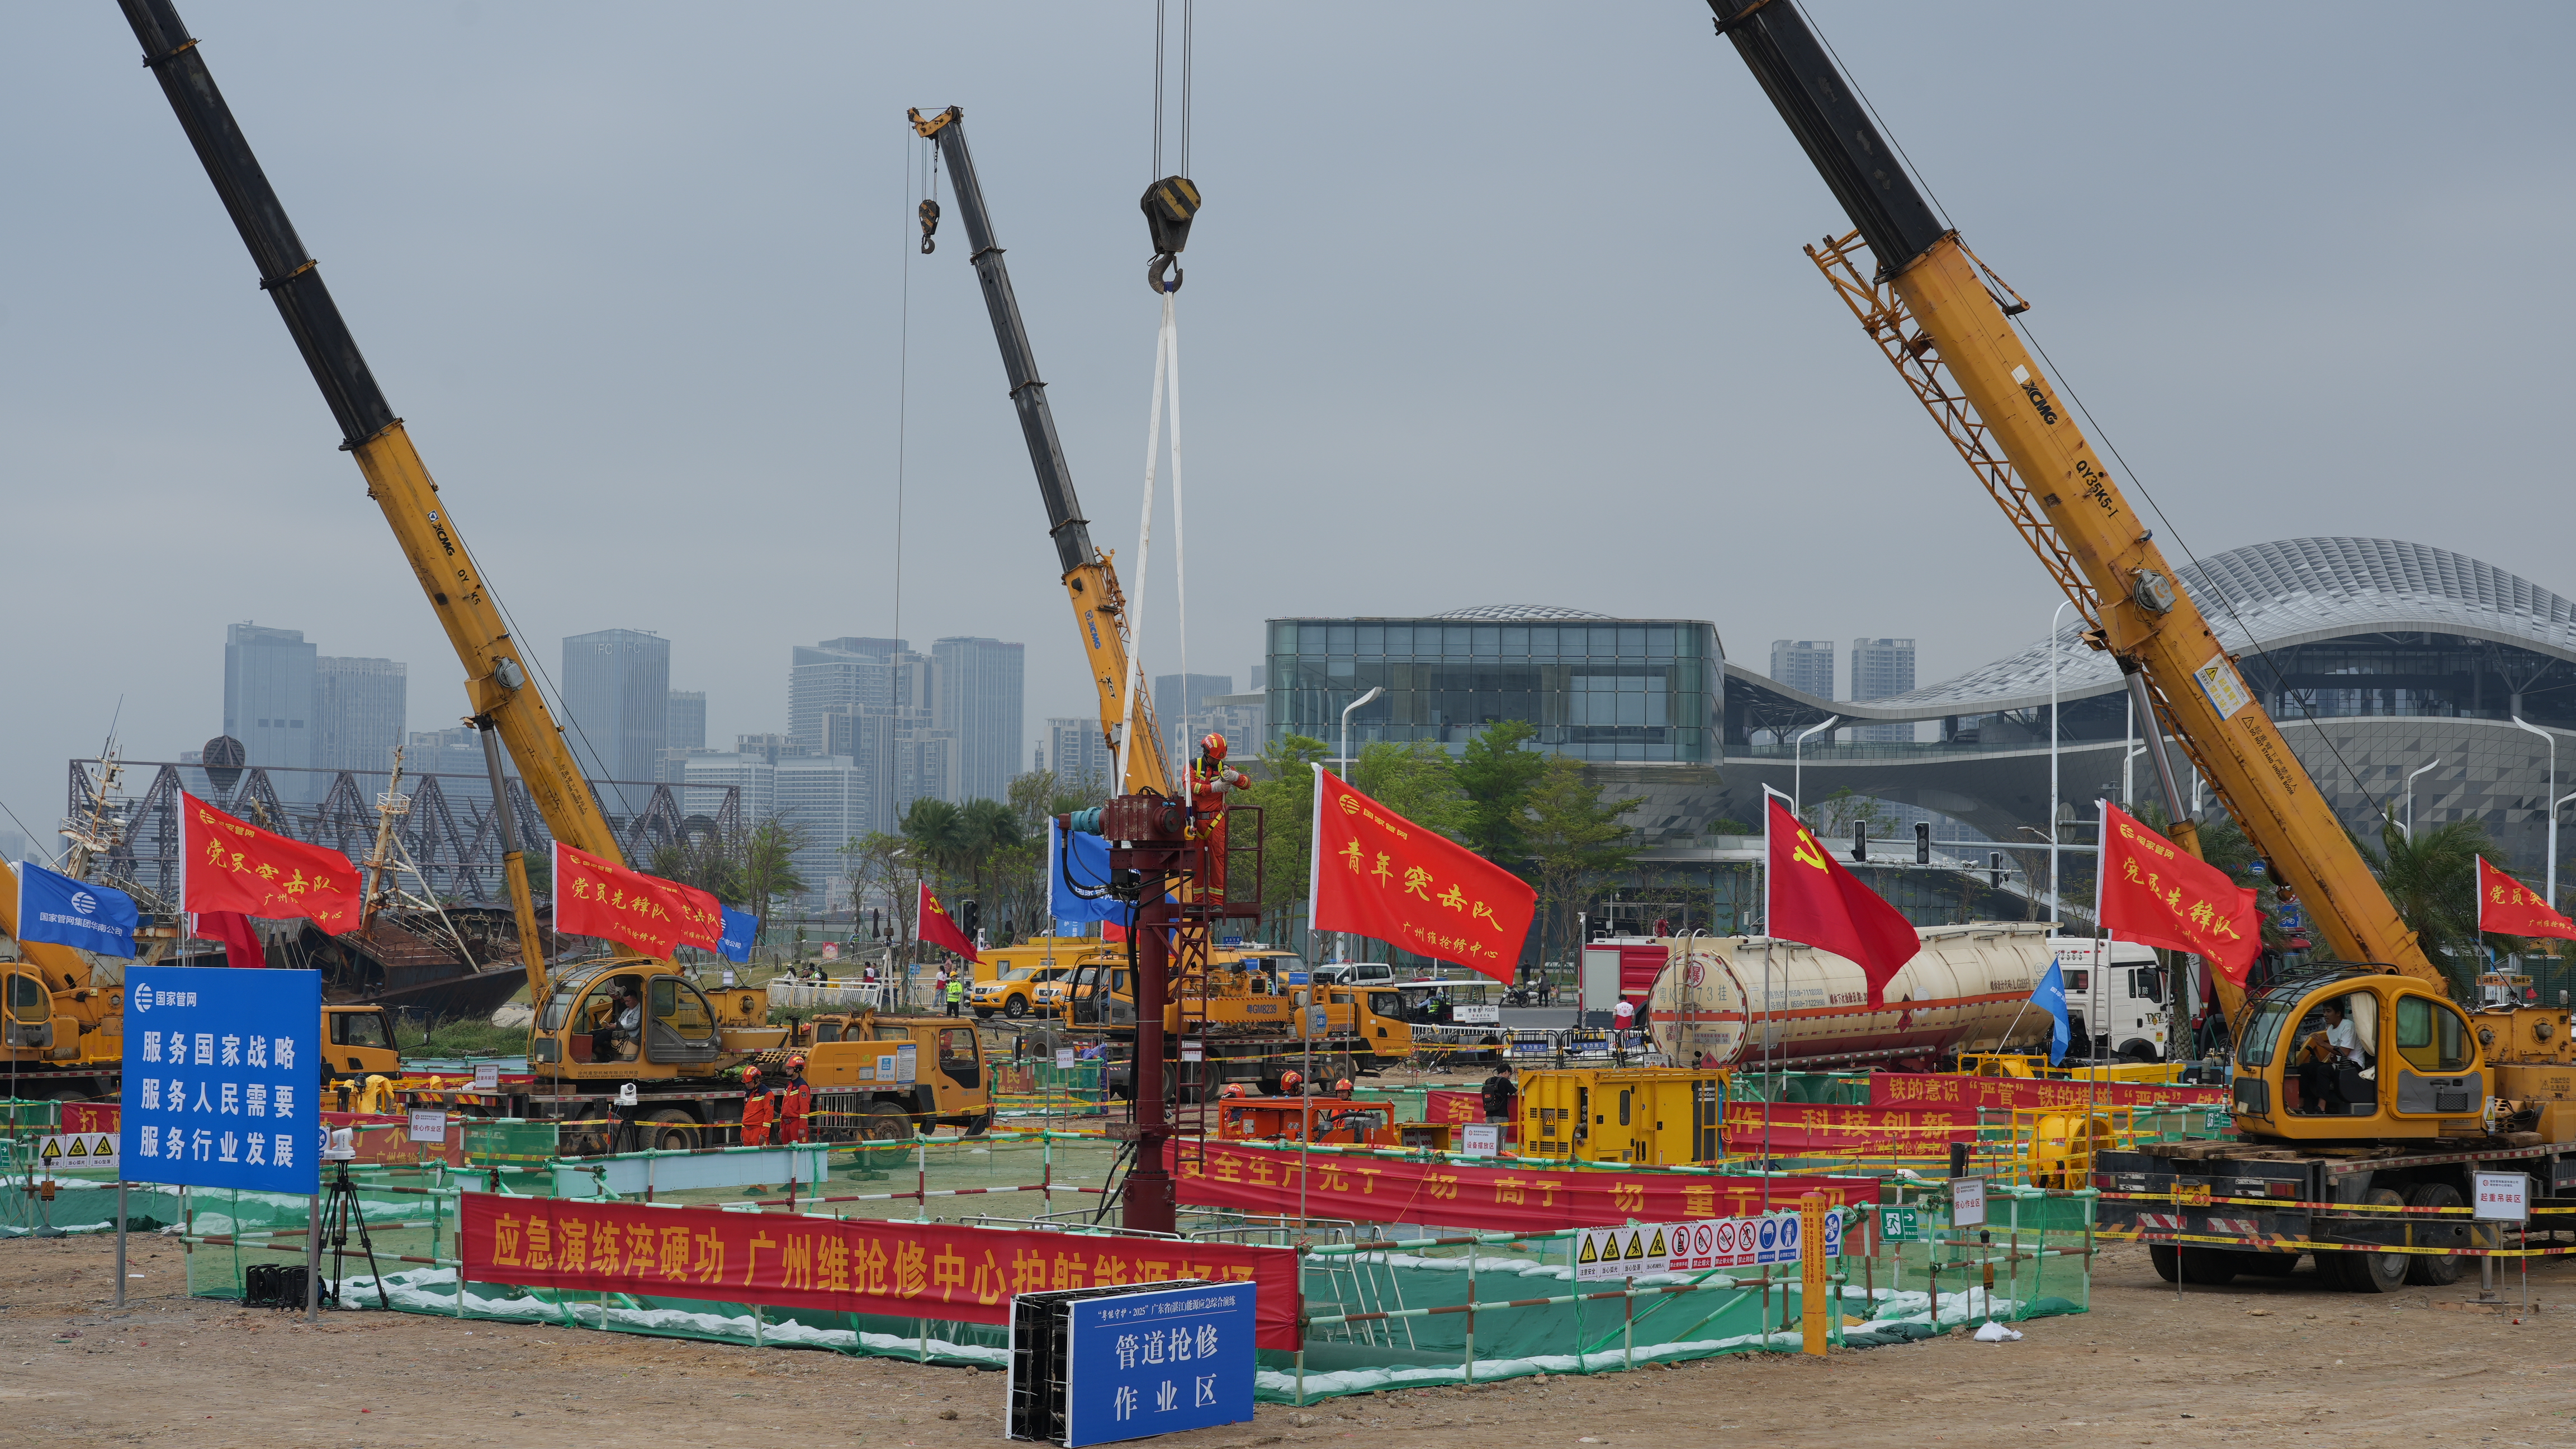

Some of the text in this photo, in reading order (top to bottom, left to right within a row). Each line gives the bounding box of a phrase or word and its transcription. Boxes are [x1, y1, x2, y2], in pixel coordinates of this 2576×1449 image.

[2021, 380, 2058, 426] XCMG
[432, 523, 455, 556] XCMG
[595, 643, 613, 655] IFC
[1087, 619, 1101, 650] XCMG
[2254, 737, 2264, 747] NOT
[2261, 747, 2274, 764] STAND
[2272, 764, 2285, 780] UNDER
[2283, 781, 2294, 795] BOOM
[1363, 808, 1409, 840] 国家管网
[2136, 835, 2175, 860] 国家管网
[583, 861, 613, 874] 国家管网
[1338, 836, 1503, 932] 青年突击队
[571, 877, 671, 923] 党员先锋队
[40, 912, 123, 937] 国家管网集团华南公司
[1403, 921, 1499, 959] 广州维抢修中心
[156, 991, 197, 1008] 国家管网
[1246, 1004, 1277, 1014] 粤GM8239
[142, 1031, 295, 1070] 服务国家战略
[141, 1078, 295, 1119] 服务人民需要
[1801, 1109, 1953, 1140] 科技创新
[140, 1125, 294, 1169] 服务行业发展
[1955, 1198, 1980, 1210] 核心作业区
[2480, 1194, 2521, 1203] 起重吊装区
[493, 1213, 725, 1285] 应急演练淬硬功
[1693, 1258, 1711, 1266] 禁止烟火
[1715, 1256, 1734, 1265] 禁止带火种
[1738, 1255, 1754, 1263] 禁止跨越
[1115, 1324, 1219, 1370] 管道抢修
[1114, 1373, 1217, 1422] 作业区
